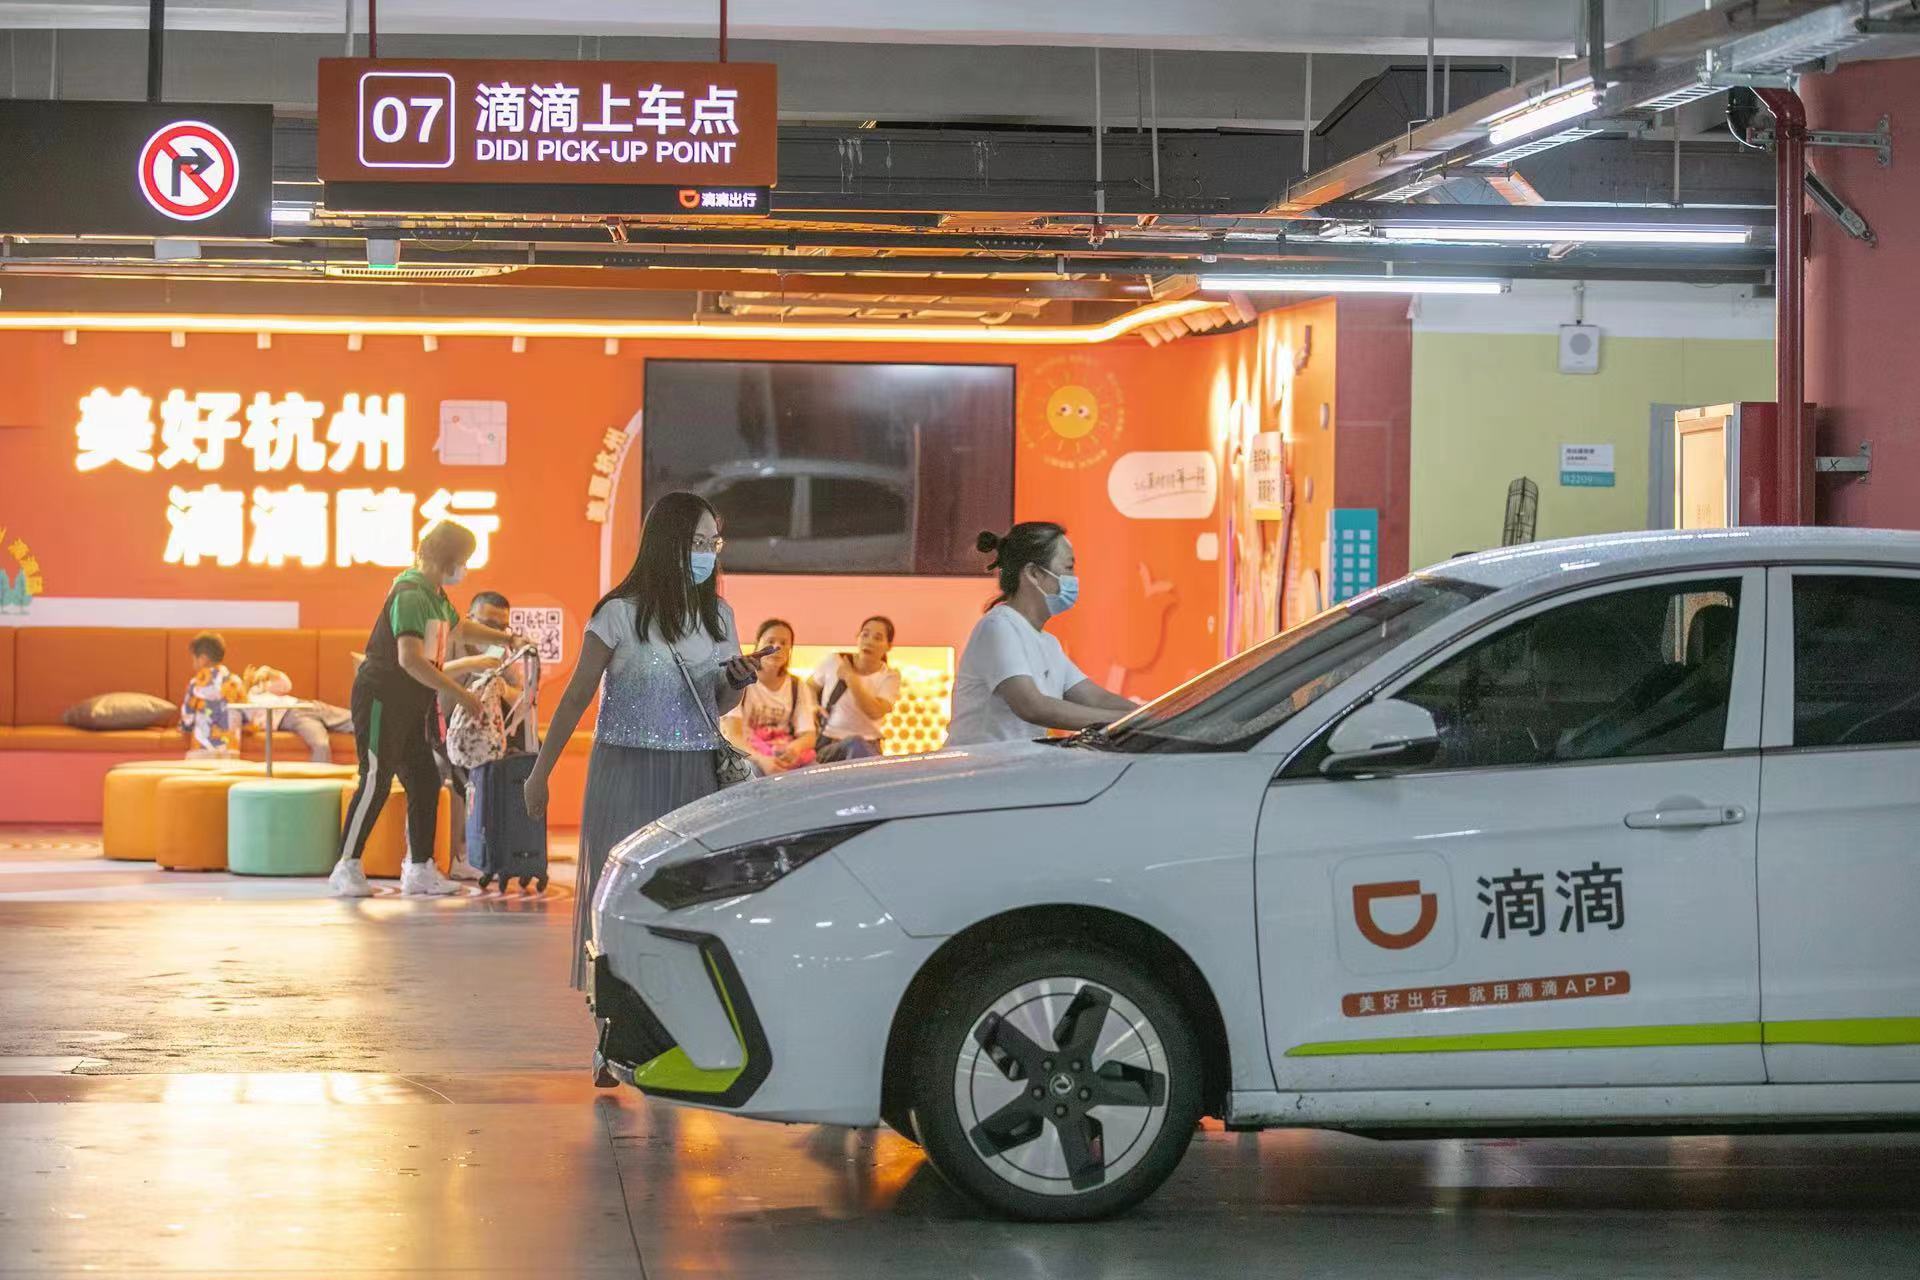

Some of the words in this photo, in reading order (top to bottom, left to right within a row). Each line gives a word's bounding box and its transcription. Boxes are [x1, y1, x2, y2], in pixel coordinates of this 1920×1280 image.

[373, 97, 444, 144] 07
[475, 83, 740, 136] 滴滴上车点
[476, 140, 528, 161] DIDI
[537, 141, 648, 163] PICK-UP
[656, 142, 737, 164] POINT
[701, 192, 757, 208] 滴滴出行
[75, 387, 407, 472] 美好杭州
[1476, 862, 1625, 939] 滴滴
[1358, 989, 1449, 1014] 美好出行
